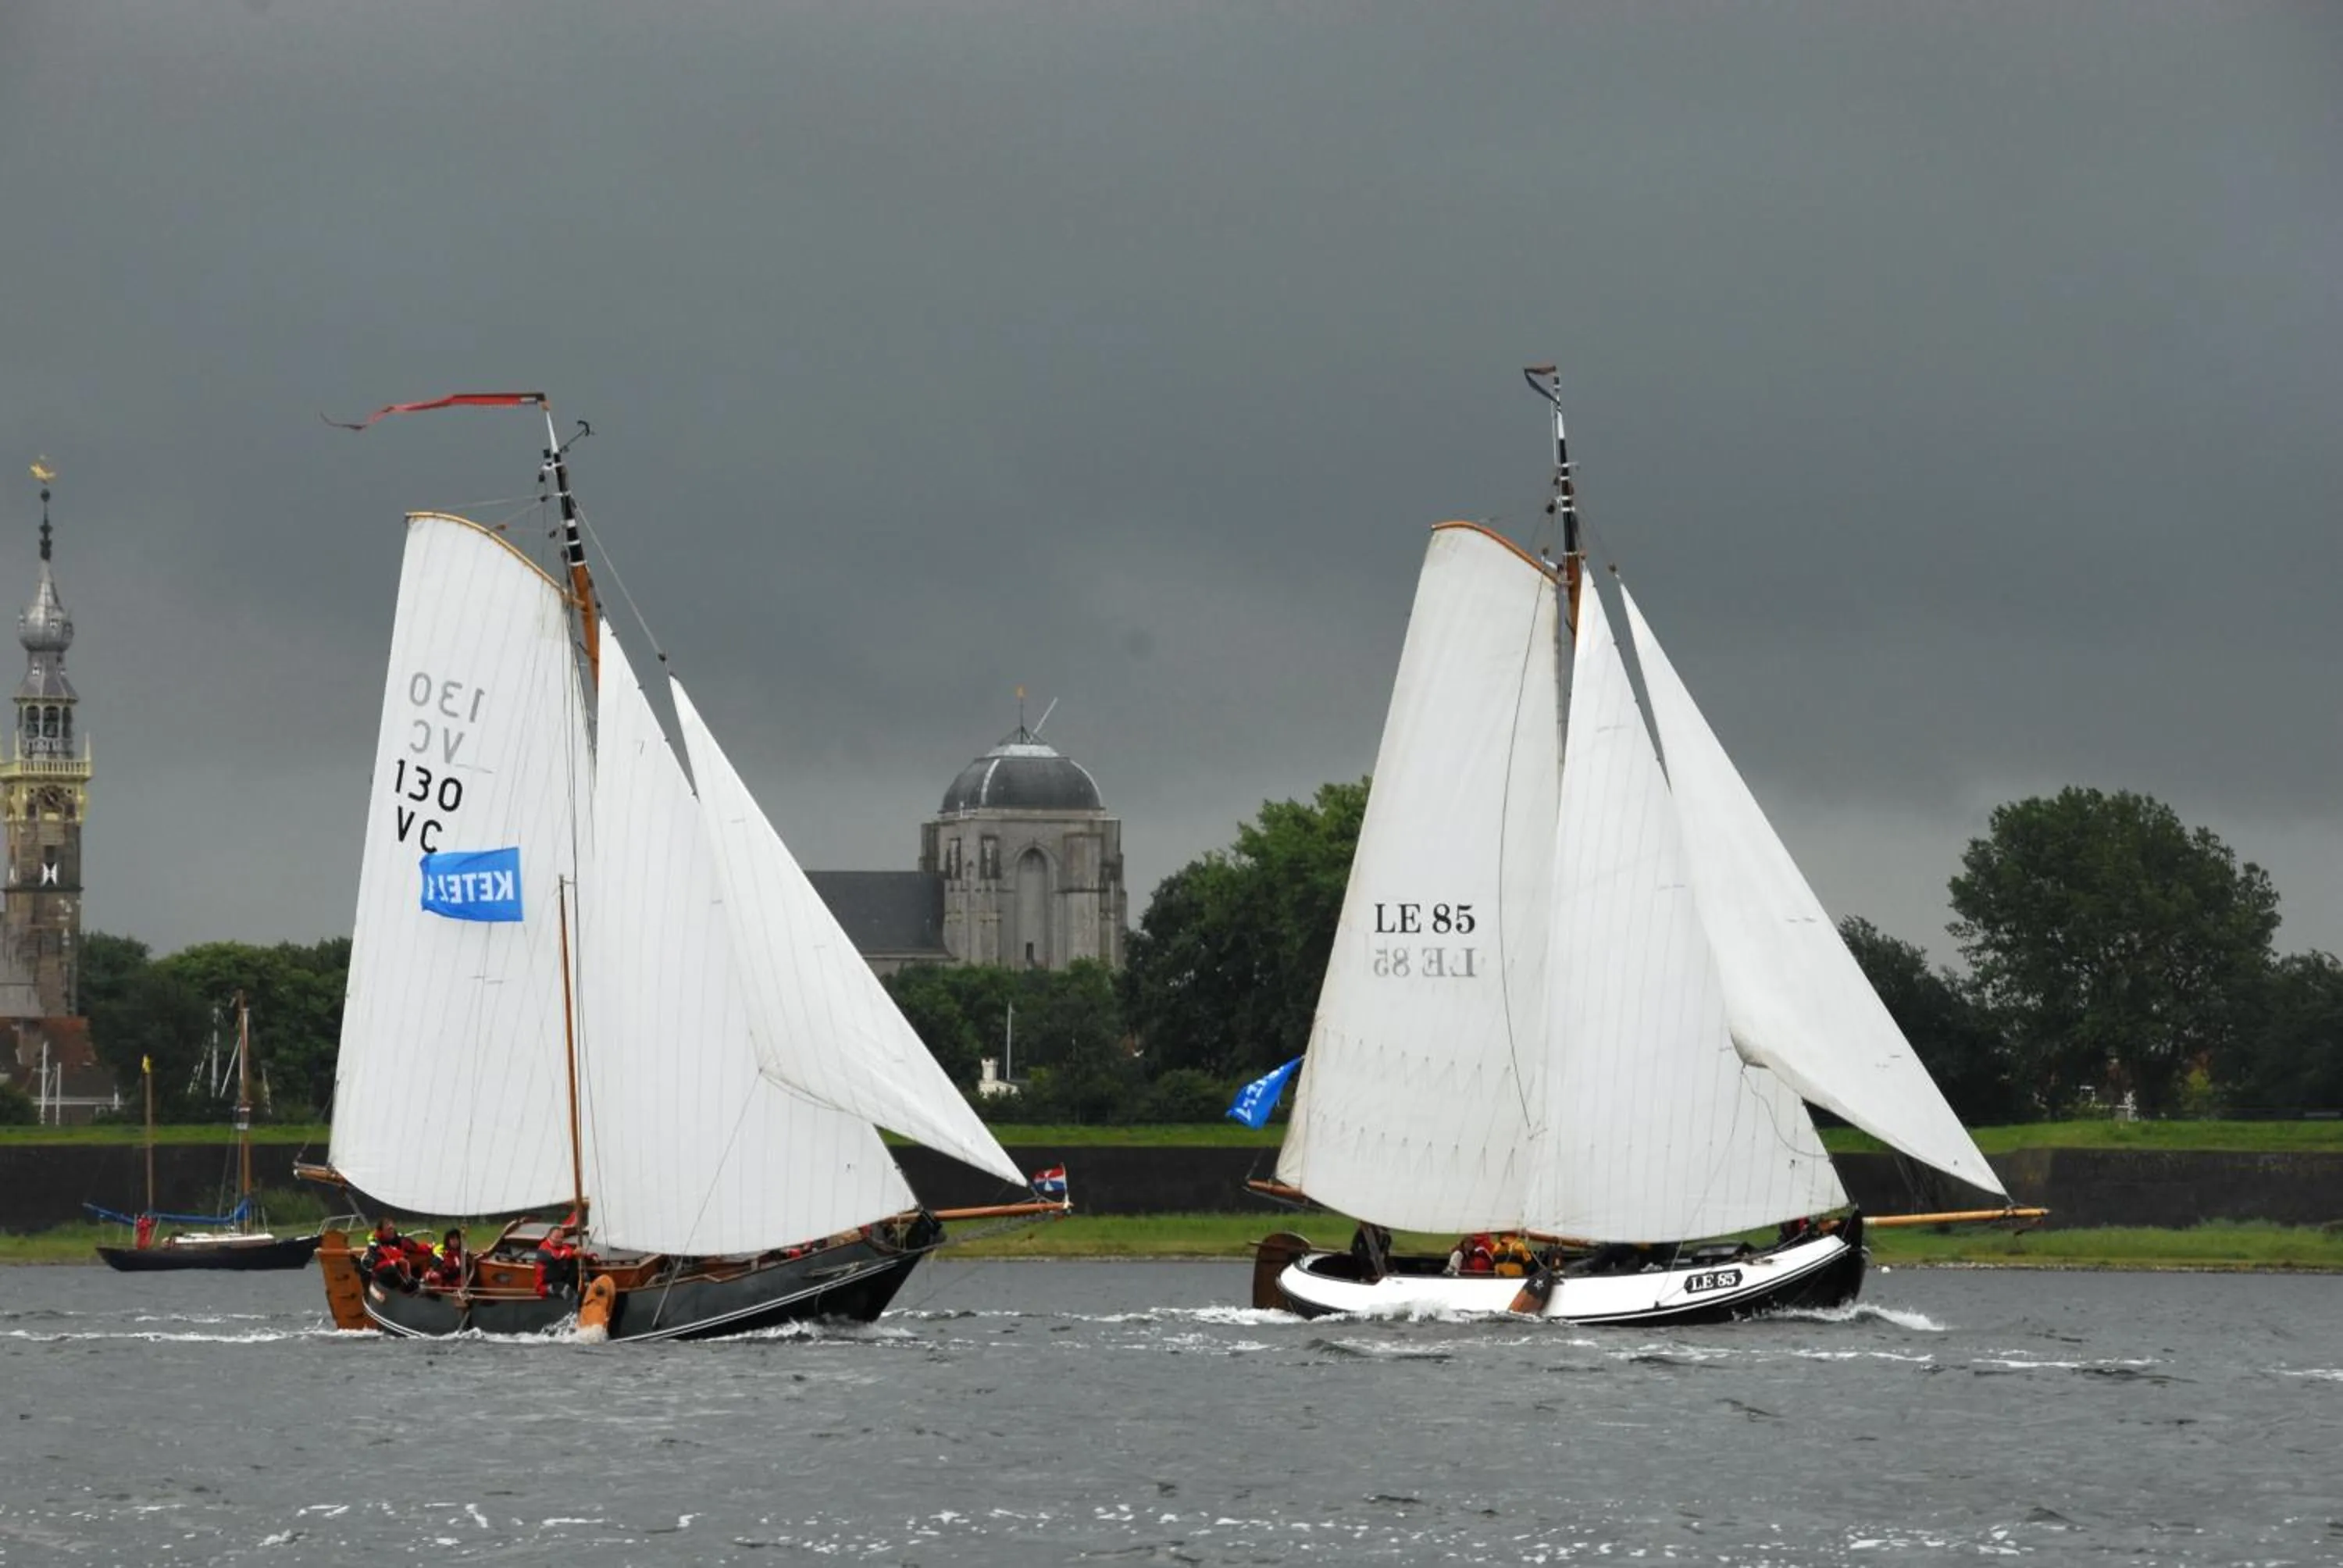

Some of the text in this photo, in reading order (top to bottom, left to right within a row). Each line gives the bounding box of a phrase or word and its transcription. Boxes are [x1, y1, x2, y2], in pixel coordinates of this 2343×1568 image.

[395, 759, 462, 812] 130
[398, 805, 442, 853] VC
[1375, 903, 1475, 934] LE 85
[1691, 1272, 1736, 1291] LE 85
